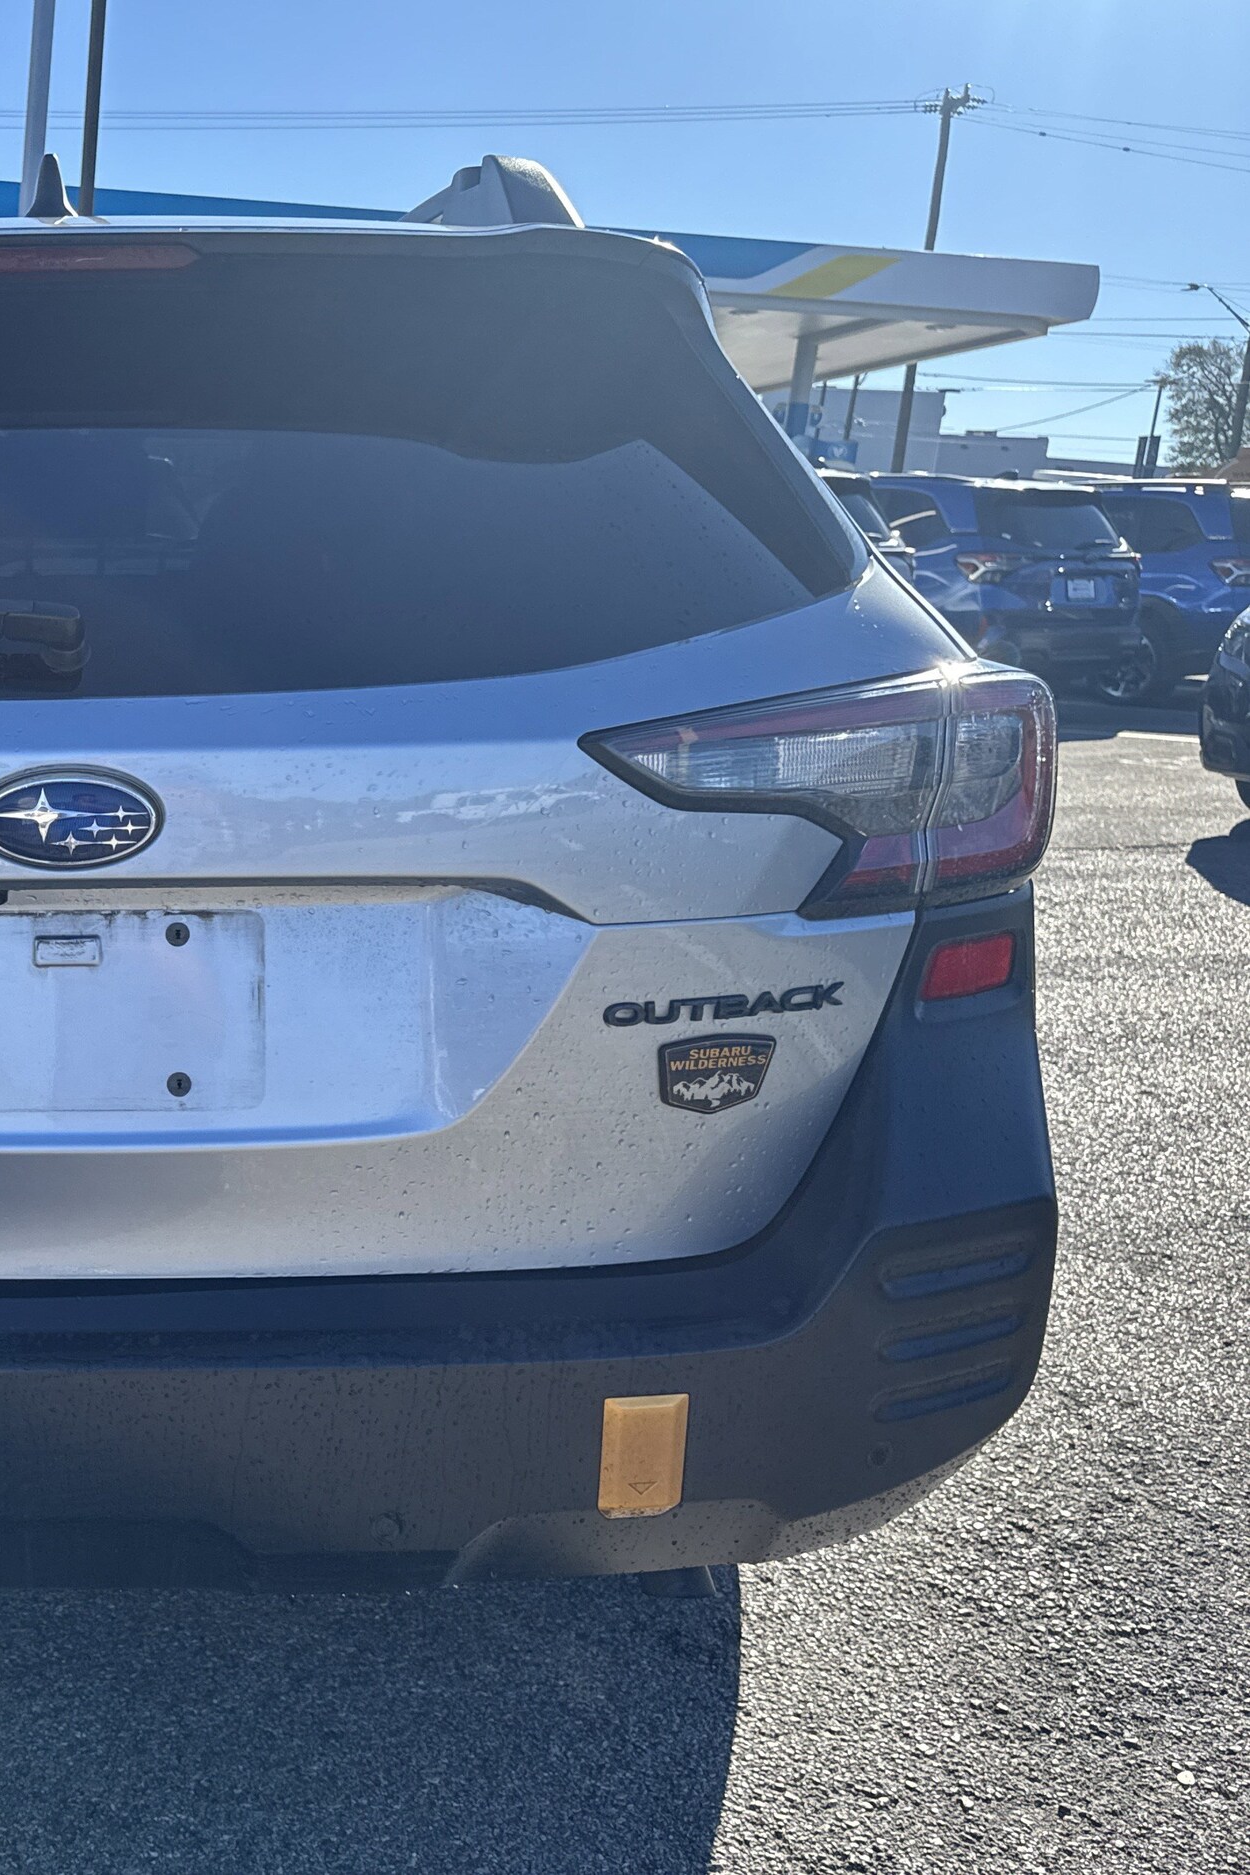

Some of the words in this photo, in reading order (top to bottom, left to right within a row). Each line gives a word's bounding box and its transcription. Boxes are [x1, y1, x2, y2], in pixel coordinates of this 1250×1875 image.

[602, 981, 844, 1027] OUTBACK
[689, 1045, 752, 1059] SUBARU
[670, 1054, 766, 1071] WILDERNESS
